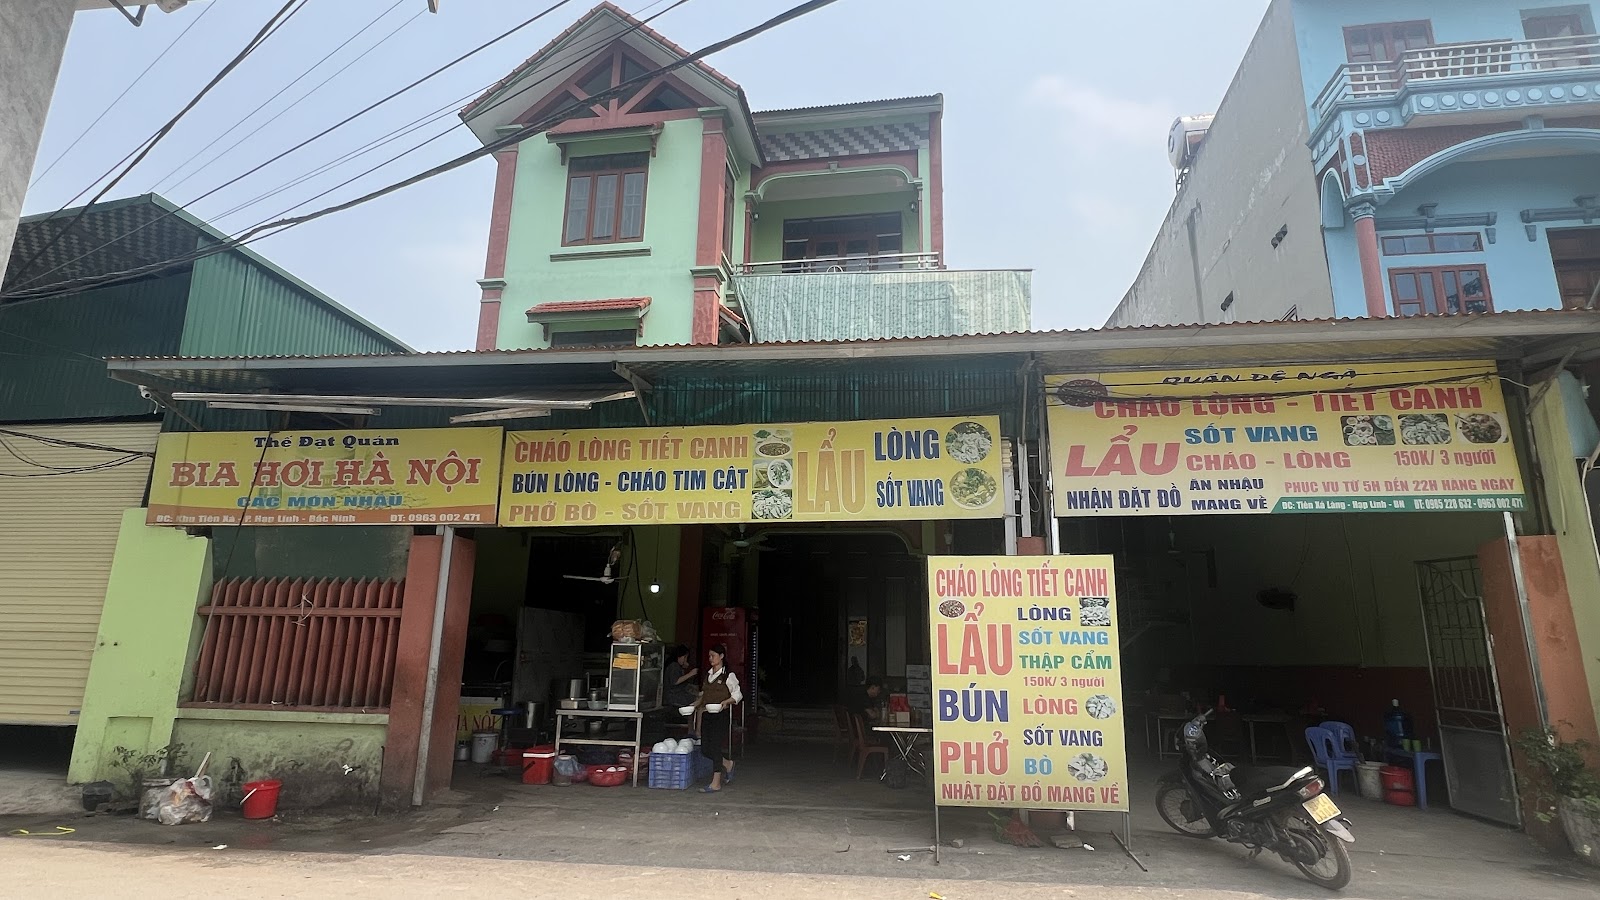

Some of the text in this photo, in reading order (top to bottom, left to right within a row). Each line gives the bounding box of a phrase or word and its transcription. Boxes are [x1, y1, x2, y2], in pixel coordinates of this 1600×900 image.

[1163, 372, 1240, 385] QUÁN
[1094, 392, 1182, 419] CHÁO
[1191, 390, 1275, 416] LÒNG
[1389, 386, 1483, 410] CANH
[254, 435, 399, 450] Thế Đạt Quán
[874, 426, 940, 461] LÒNG
[1184, 422, 1318, 444] SỐT VANG
[514, 431, 749, 463] CHÁO LÒNG TIẾT CANH
[1065, 425, 1180, 477] LẨU
[1393, 449, 1497, 467] 150K/ 3 người
[169, 450, 482, 493] BIA HƠI HÀ NỘI
[797, 427, 866, 514] LẨU
[1186, 452, 1256, 471] CHÁO
[1283, 450, 1351, 469] LÒNG
[512, 469, 547, 494] BÚN
[554, 469, 600, 493] LÒNG
[617, 467, 667, 492] CHÁO
[673, 470, 706, 491] TIM
[712, 465, 749, 494] CẬT
[876, 472, 945, 508] SỐT VANG
[1189, 477, 1264, 492] ĂN NHẬU
[1363, 480, 1381, 492] 5H
[1412, 480, 1438, 492] 22H
[1067, 482, 1182, 513] NHẬN ĐẶT ĐỒ
[1191, 494, 1268, 511] MANG VỀ
[1512, 497, 1524, 508] 471
[408, 513, 436, 522] 0963
[439, 513, 462, 522] 002
[463, 513, 481, 522] 471
[509, 500, 558, 522] PHỞ
[564, 501, 597, 522] BÒ
[622, 497, 669, 521] SỐT
[676, 501, 742, 519] VANG
[935, 560, 1108, 597] CHÁO LÒNG TIẾT CANH
[1017, 604, 1072, 621] LÒNG
[937, 601, 1014, 676] LẨU
[1018, 626, 1109, 645] SỐT VANG
[1019, 649, 1112, 672] THẬP CẨM
[1023, 676, 1105, 688] 150K/ 3 người
[938, 682, 1009, 723] BÚN
[1023, 695, 1078, 715] LÒNG
[1023, 723, 1103, 747] SỐT VANG
[939, 730, 1010, 776] PHỞ
[1024, 754, 1052, 775] BÒ
[942, 780, 982, 804] NHẬT
[986, 781, 1016, 805] ĐẶT
[1047, 785, 1096, 804] MANG
[1100, 782, 1120, 805] VỀ
